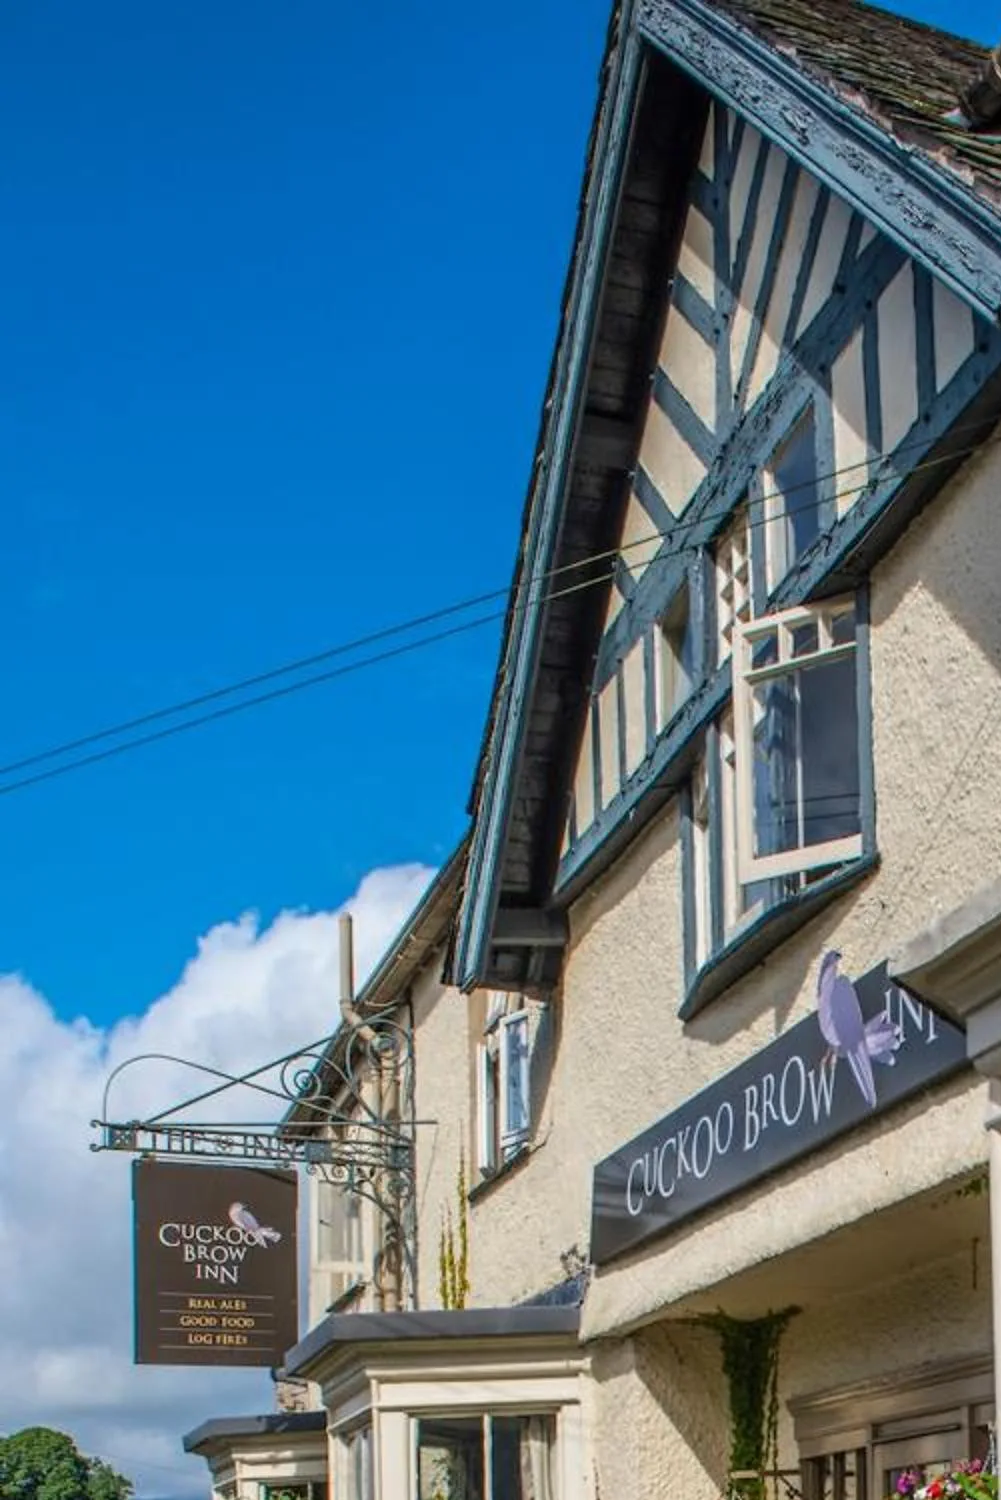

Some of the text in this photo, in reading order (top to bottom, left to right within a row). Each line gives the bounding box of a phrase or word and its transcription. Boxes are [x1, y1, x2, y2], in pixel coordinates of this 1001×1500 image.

[625, 1101, 734, 1216] CUCKOO
[743, 1054, 838, 1152] BROW
[159, 1222, 261, 1247] CUCKOO
[184, 1243, 247, 1264] BROW
[195, 1263, 239, 1284] INN
[188, 1298, 247, 1311] REAL ALES
[180, 1315, 255, 1328] GOOD FOOD
[188, 1333, 248, 1346] LOG FIRES
